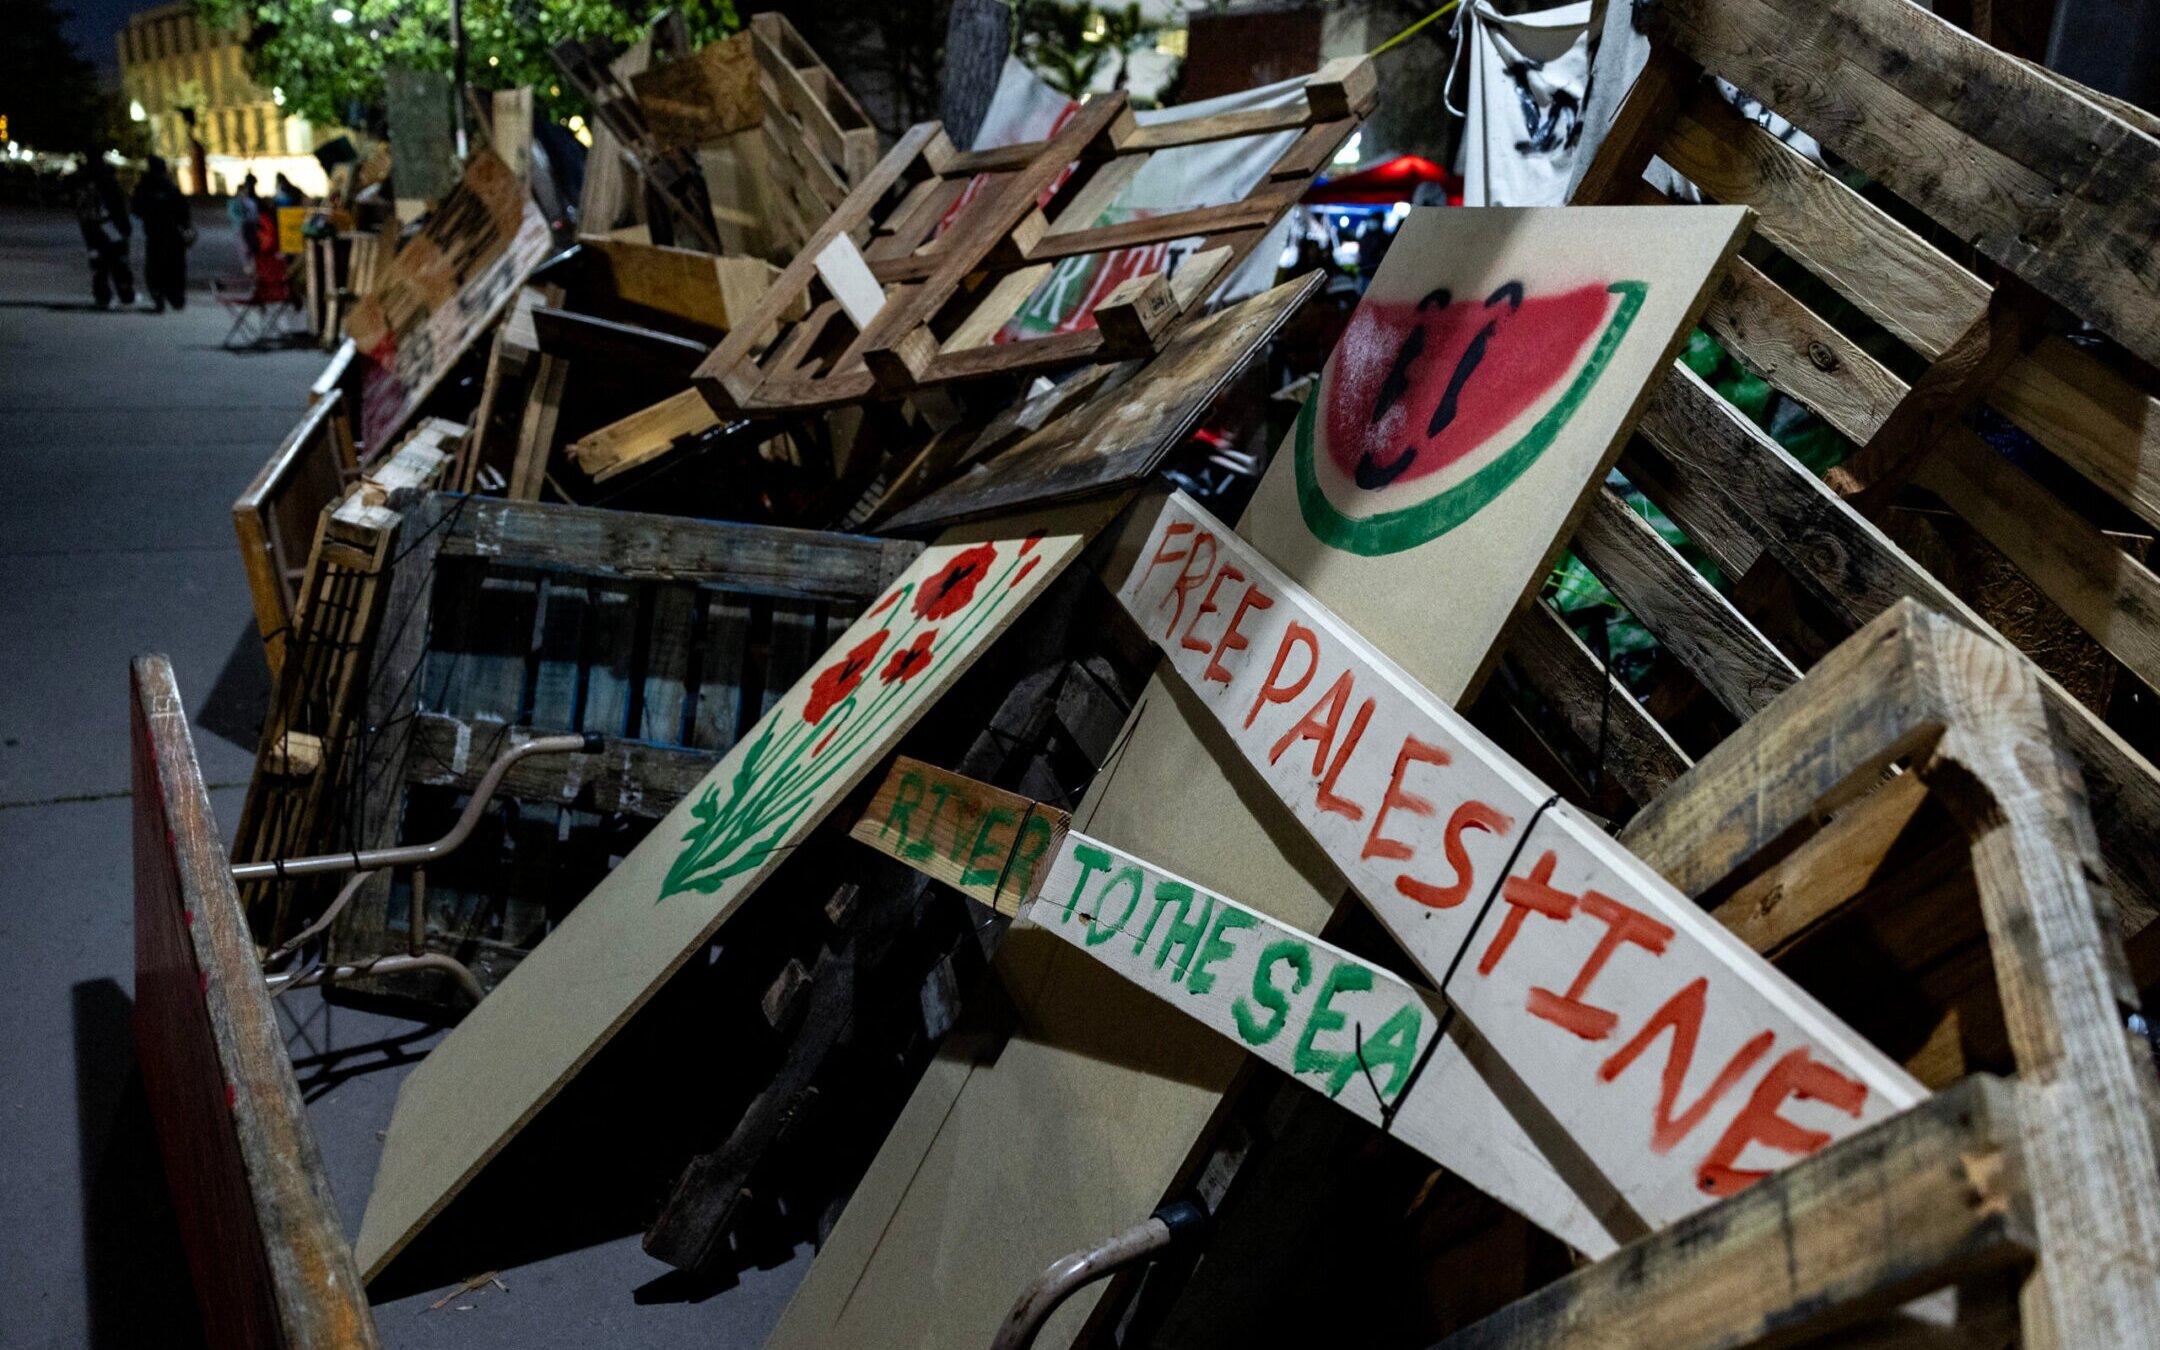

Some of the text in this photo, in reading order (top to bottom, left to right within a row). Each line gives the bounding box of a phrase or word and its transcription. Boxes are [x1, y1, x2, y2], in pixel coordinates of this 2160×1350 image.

[1134, 520, 1275, 684] FREE
[879, 769, 1052, 904] RIVER
[1230, 939, 1422, 1099] SEA
